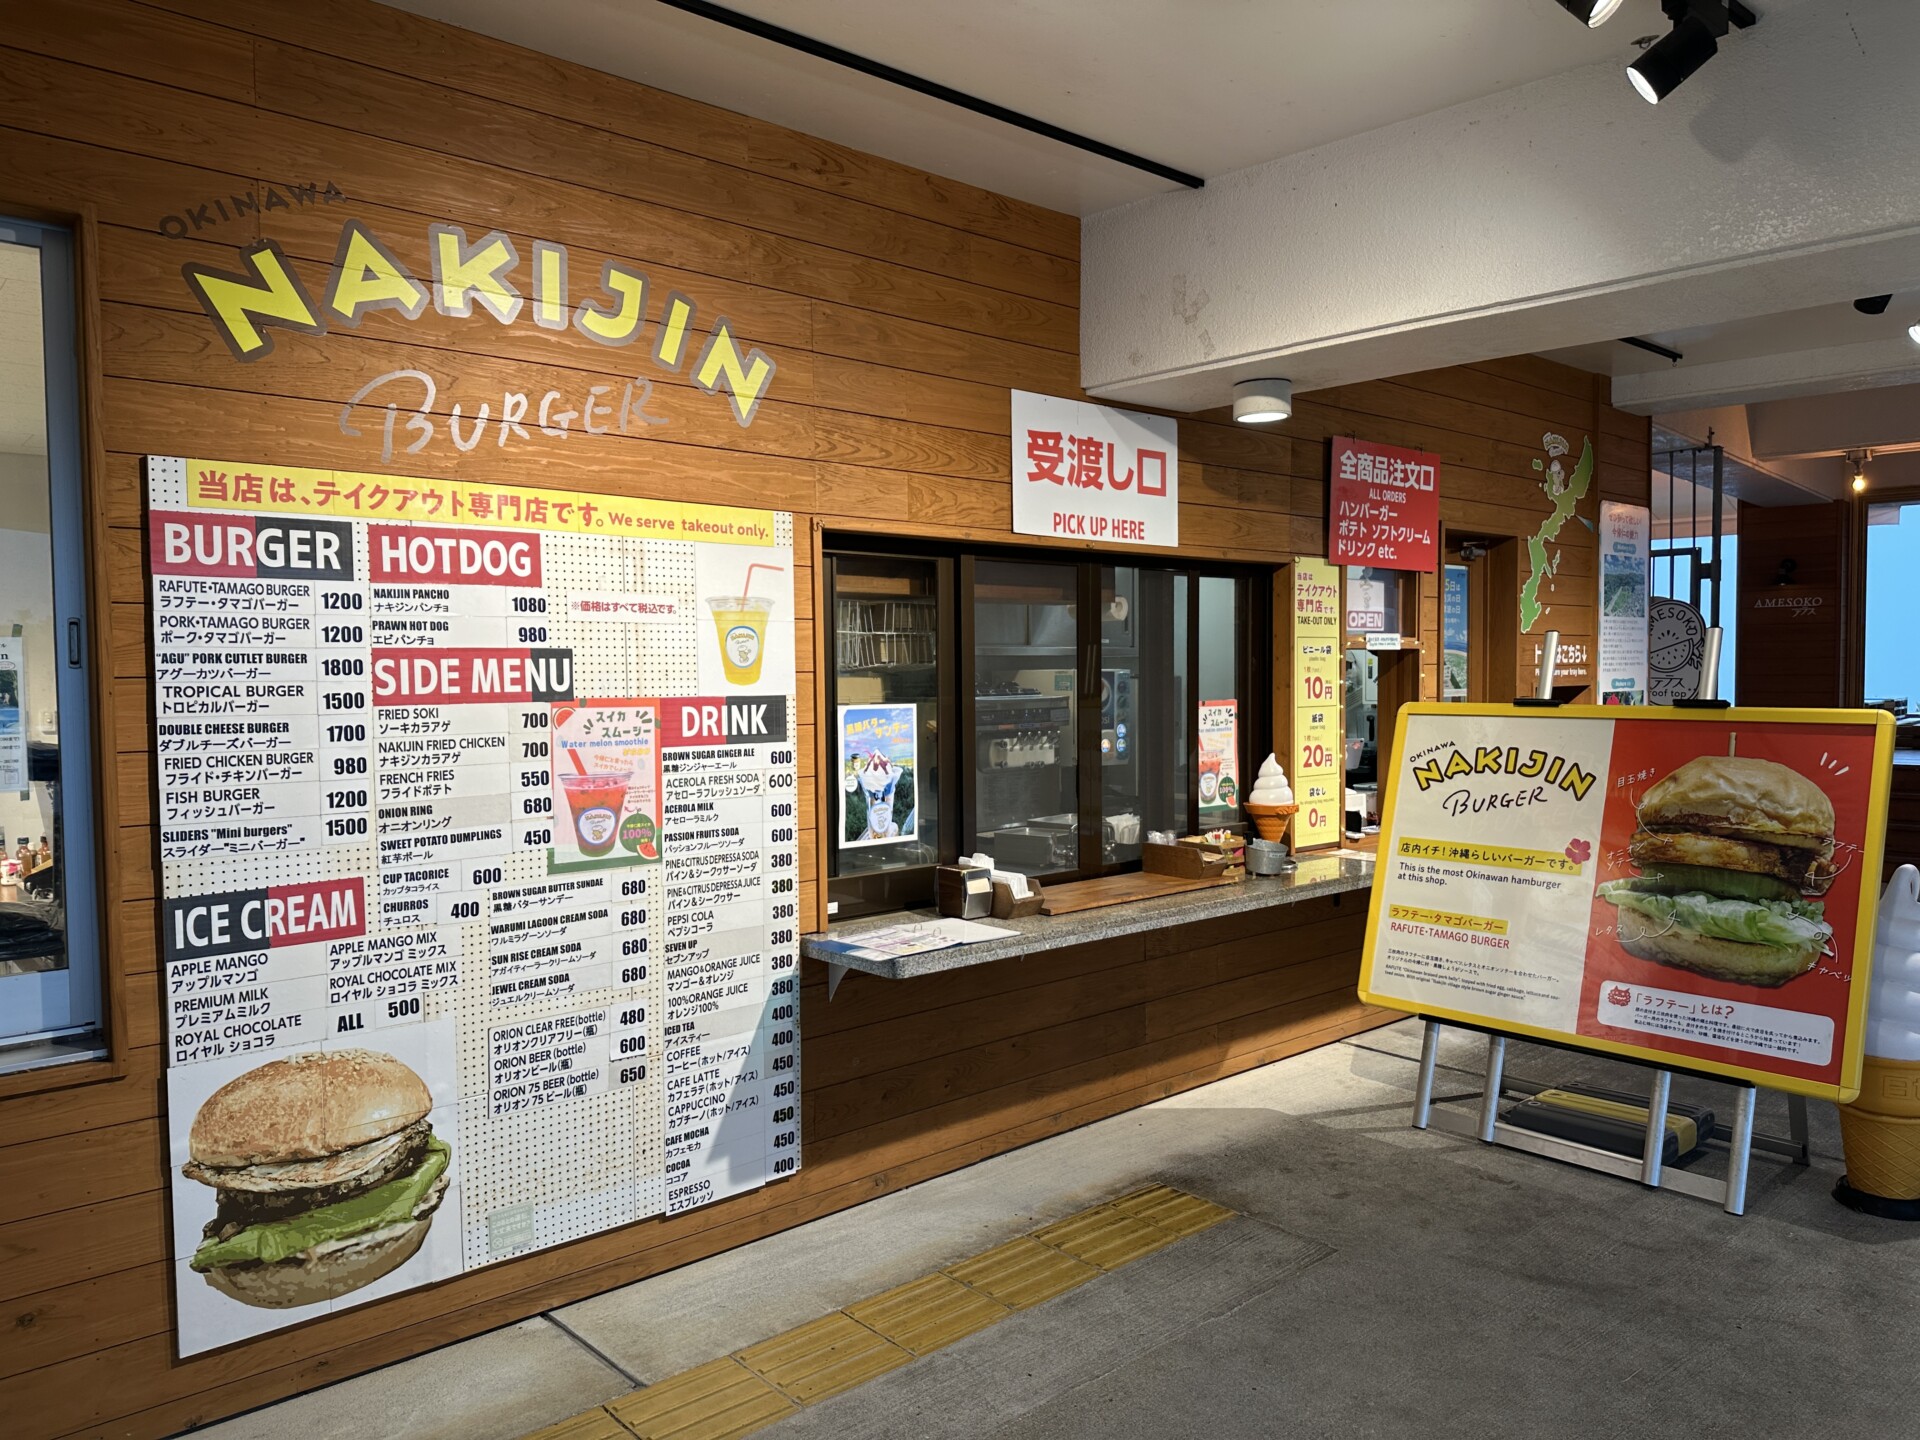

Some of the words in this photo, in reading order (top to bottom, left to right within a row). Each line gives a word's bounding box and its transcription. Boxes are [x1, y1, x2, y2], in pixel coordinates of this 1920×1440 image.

[160, 180, 348, 240] OKINAWA
[182, 218, 776, 427] NAKIJIN
[340, 369, 669, 463] BURGER
[1027, 429, 1167, 497] 受渡し口
[1339, 450, 1435, 491] 全商品注文口
[1369, 488, 1380, 500] ALL
[1382, 489, 1406, 504] ORDERS
[199, 470, 604, 527] 当店は、テイクアウト専門店です。
[608, 512, 633, 526] We
[636, 517, 674, 530] serve
[682, 518, 733, 535] takeout
[737, 523, 769, 540] only.
[1339, 501, 1398, 521] ハンバーガー
[1053, 512, 1085, 535] PICK
[1090, 516, 1108, 536] UP
[1112, 518, 1145, 540] HERE
[1339, 519, 1367, 538] ポテト
[1372, 524, 1431, 545] ソフトクリーム
[164, 523, 341, 570] BURGER
[1338, 539, 1376, 558] ドリンク
[1378, 544, 1397, 560] etc.
[381, 535, 531, 577] HOTDOG
[266, 583, 310, 597] BURGER
[1297, 584, 1337, 598] テイクアウト
[321, 592, 362, 610] 1200
[1755, 597, 1822, 608] AMESOKO
[262, 617, 310, 630] BURGER
[372, 620, 408, 631] PRAWN
[409, 621, 428, 632] HOT
[430, 621, 449, 632] DOG
[1297, 616, 1323, 625] TAKE-OUT
[1323, 616, 1338, 625] ONLY
[1348, 613, 1382, 627] OPEN
[1650, 607, 1698, 637] MESOKO
[321, 626, 363, 643] 1200
[518, 627, 547, 643] 980
[192, 653, 223, 664] PORK
[224, 653, 263, 664] CUTLET
[265, 653, 308, 664] BURGER
[321, 660, 363, 676] 1800
[374, 658, 460, 696] SIDE
[471, 658, 570, 694] MENU
[163, 685, 240, 698] TROPICAL
[246, 685, 304, 697] BURGER
[1650, 688, 1667, 697] oof
[1671, 689, 1686, 700] top
[162, 701, 270, 715] トロピカルバーガー
[323, 692, 364, 710] 1500
[378, 708, 410, 720] FRIED
[412, 707, 439, 719] SOKI
[521, 713, 548, 728] 700
[596, 711, 626, 723] スイカ
[682, 704, 768, 738] DRINK
[159, 724, 203, 736] DOUBLE
[205, 723, 245, 735] CHEESE
[247, 723, 289, 734] BURGER
[327, 724, 365, 742] 1700
[379, 720, 450, 735] ソーキカラアゲ
[159, 738, 291, 752] ダブルチーズバーガー
[561, 740, 587, 749] Water
[589, 739, 612, 747] melon
[614, 738, 649, 747] smoothie
[1409, 740, 1456, 763] OKINAWA
[379, 772, 422, 785] FRENCH
[426, 769, 455, 782] FRIES
[521, 770, 549, 787] 550
[666, 777, 707, 789] ACEROLA
[708, 775, 734, 786] FRESH
[736, 772, 760, 784] SODA
[768, 774, 792, 788] 600
[1412, 746, 1597, 802] NAKIJIN
[166, 792, 198, 805] FISH
[203, 789, 260, 802] BURGER
[326, 790, 367, 808] 1200
[381, 784, 452, 800] フライドポテト
[1442, 786, 1548, 817] BURGER
[167, 803, 275, 820] フィッシュバーガー
[162, 829, 208, 843] SLIDERS
[211, 826, 242, 840] "Mini
[243, 824, 293, 839] burgers"
[326, 818, 367, 836] 1500
[383, 873, 402, 884] CUP
[403, 869, 449, 883] TACORICE
[473, 868, 501, 885] 600
[1397, 873, 1406, 881] at
[1407, 873, 1424, 884] this
[1425, 876, 1447, 887] shop.
[1400, 862, 1416, 872] This
[1418, 864, 1425, 873] is
[1427, 864, 1441, 875] the
[1442, 868, 1463, 877] most
[1465, 869, 1509, 884] Okinawan
[1511, 873, 1561, 890] hamburger
[174, 904, 230, 949] ICE
[241, 889, 357, 940] CREAM
[621, 909, 646, 926] 680
[668, 914, 689, 926] PEPSI
[691, 910, 714, 922] COLA
[772, 904, 793, 919] 380
[491, 920, 526, 935] WARUMI
[528, 916, 559, 930] LAGOON
[560, 912, 587, 926] CREAM
[588, 909, 609, 921] SODA
[1470, 935, 1510, 949] BURGER
[171, 961, 212, 978] APPLE
[215, 953, 269, 972] MANGO
[174, 993, 235, 1013] PREMIUM
[238, 988, 269, 1002] MILK
[388, 998, 420, 1018] 500
[337, 1013, 364, 1032] ALL
[620, 1035, 646, 1053] 600
[494, 1057, 526, 1071] ORION
[528, 1050, 552, 1065] BEER
[553, 1042, 586, 1060] (bottle)
[666, 1046, 701, 1062] COFFEE
[773, 1157, 795, 1175] 400
[669, 1180, 711, 1201] ESPRESSO
